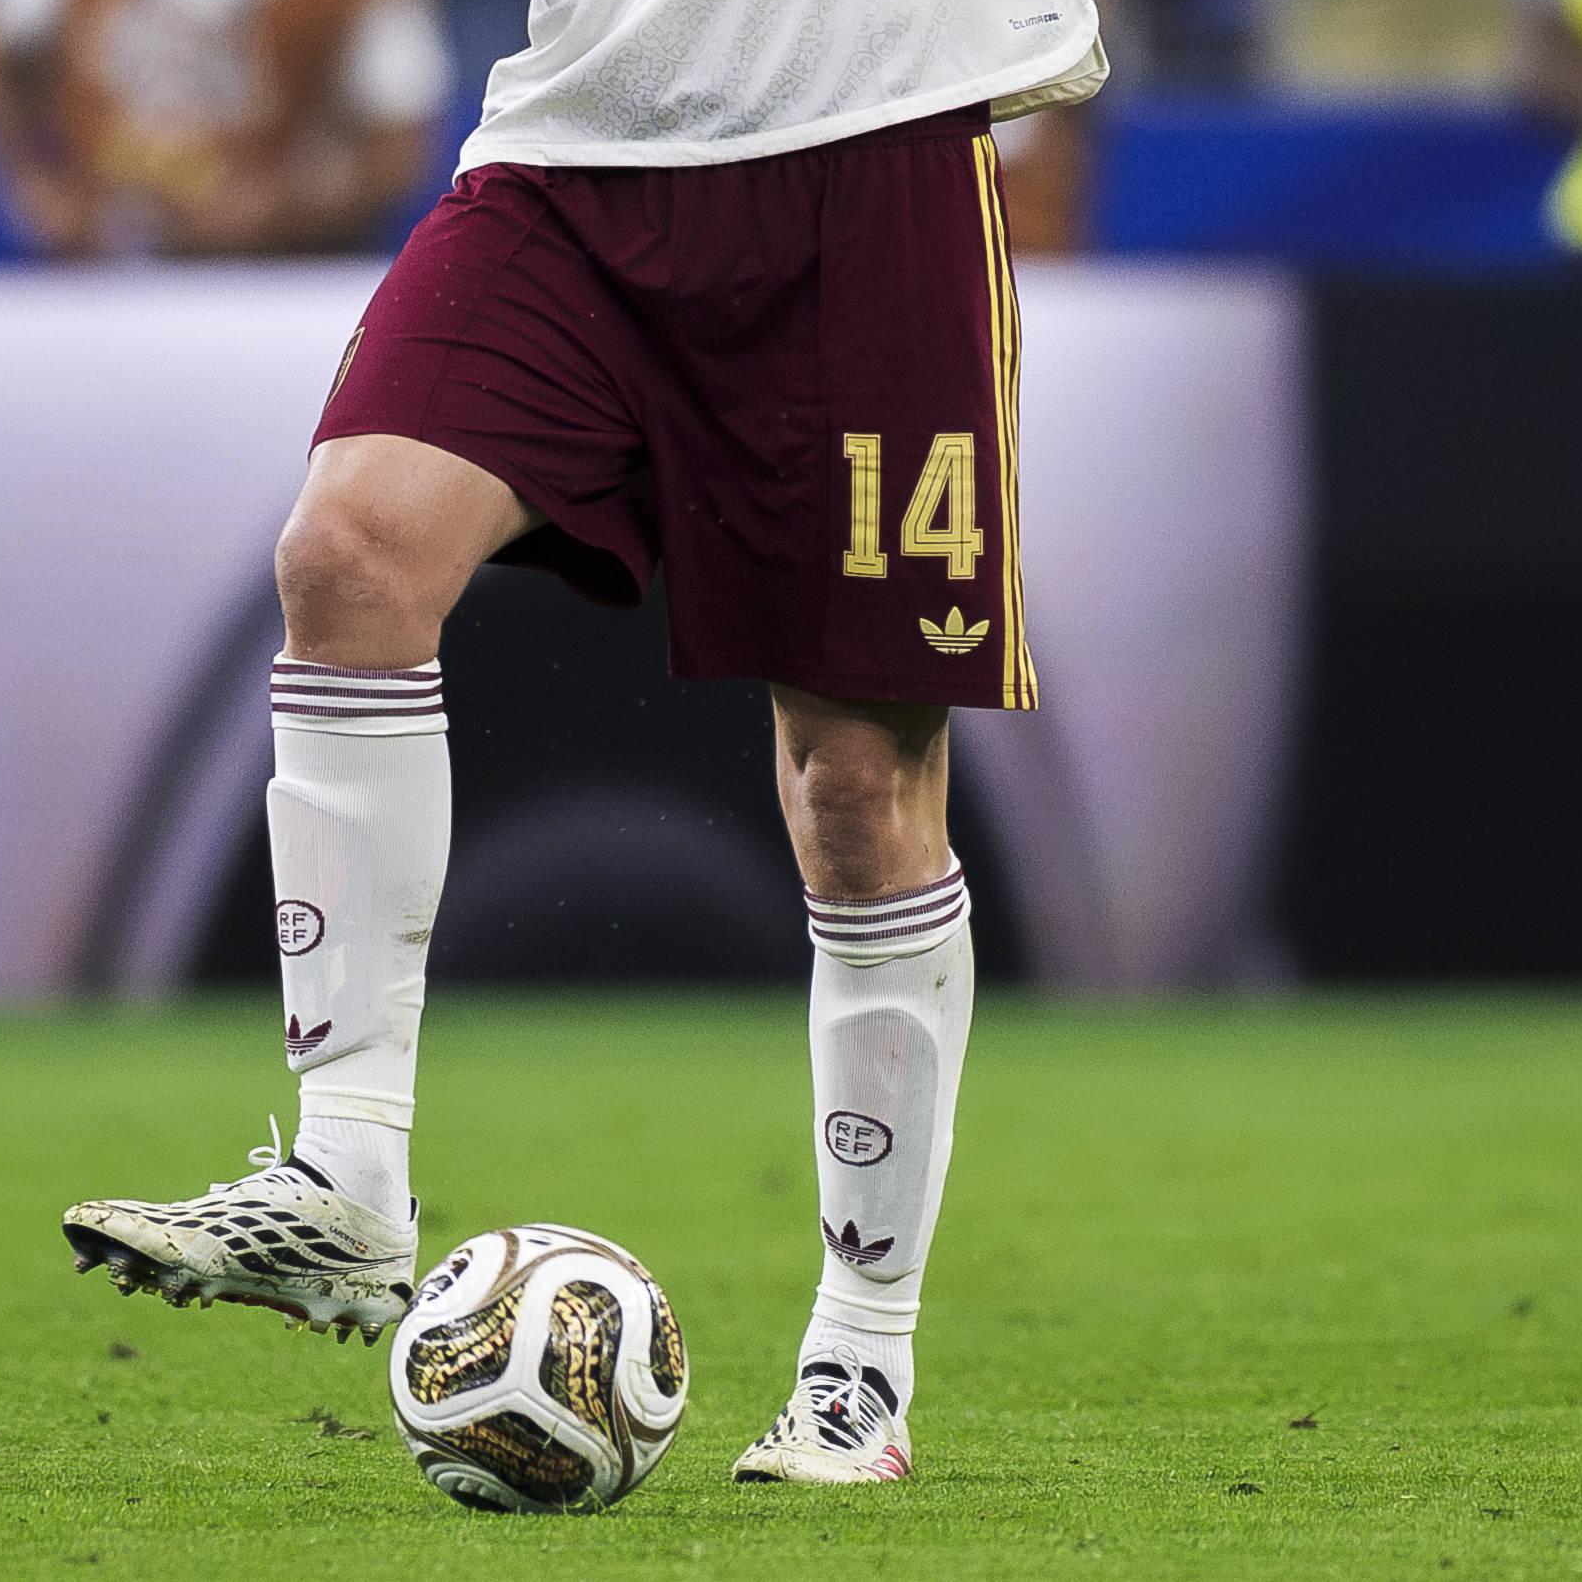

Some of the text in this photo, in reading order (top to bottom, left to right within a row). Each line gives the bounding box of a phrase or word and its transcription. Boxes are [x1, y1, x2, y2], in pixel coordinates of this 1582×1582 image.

[843, 433, 983, 579] 14
[280, 912, 307, 926] RF
[281, 929, 307, 944] EF
[836, 1121, 874, 1139] RF
[835, 1137, 872, 1154] EF
